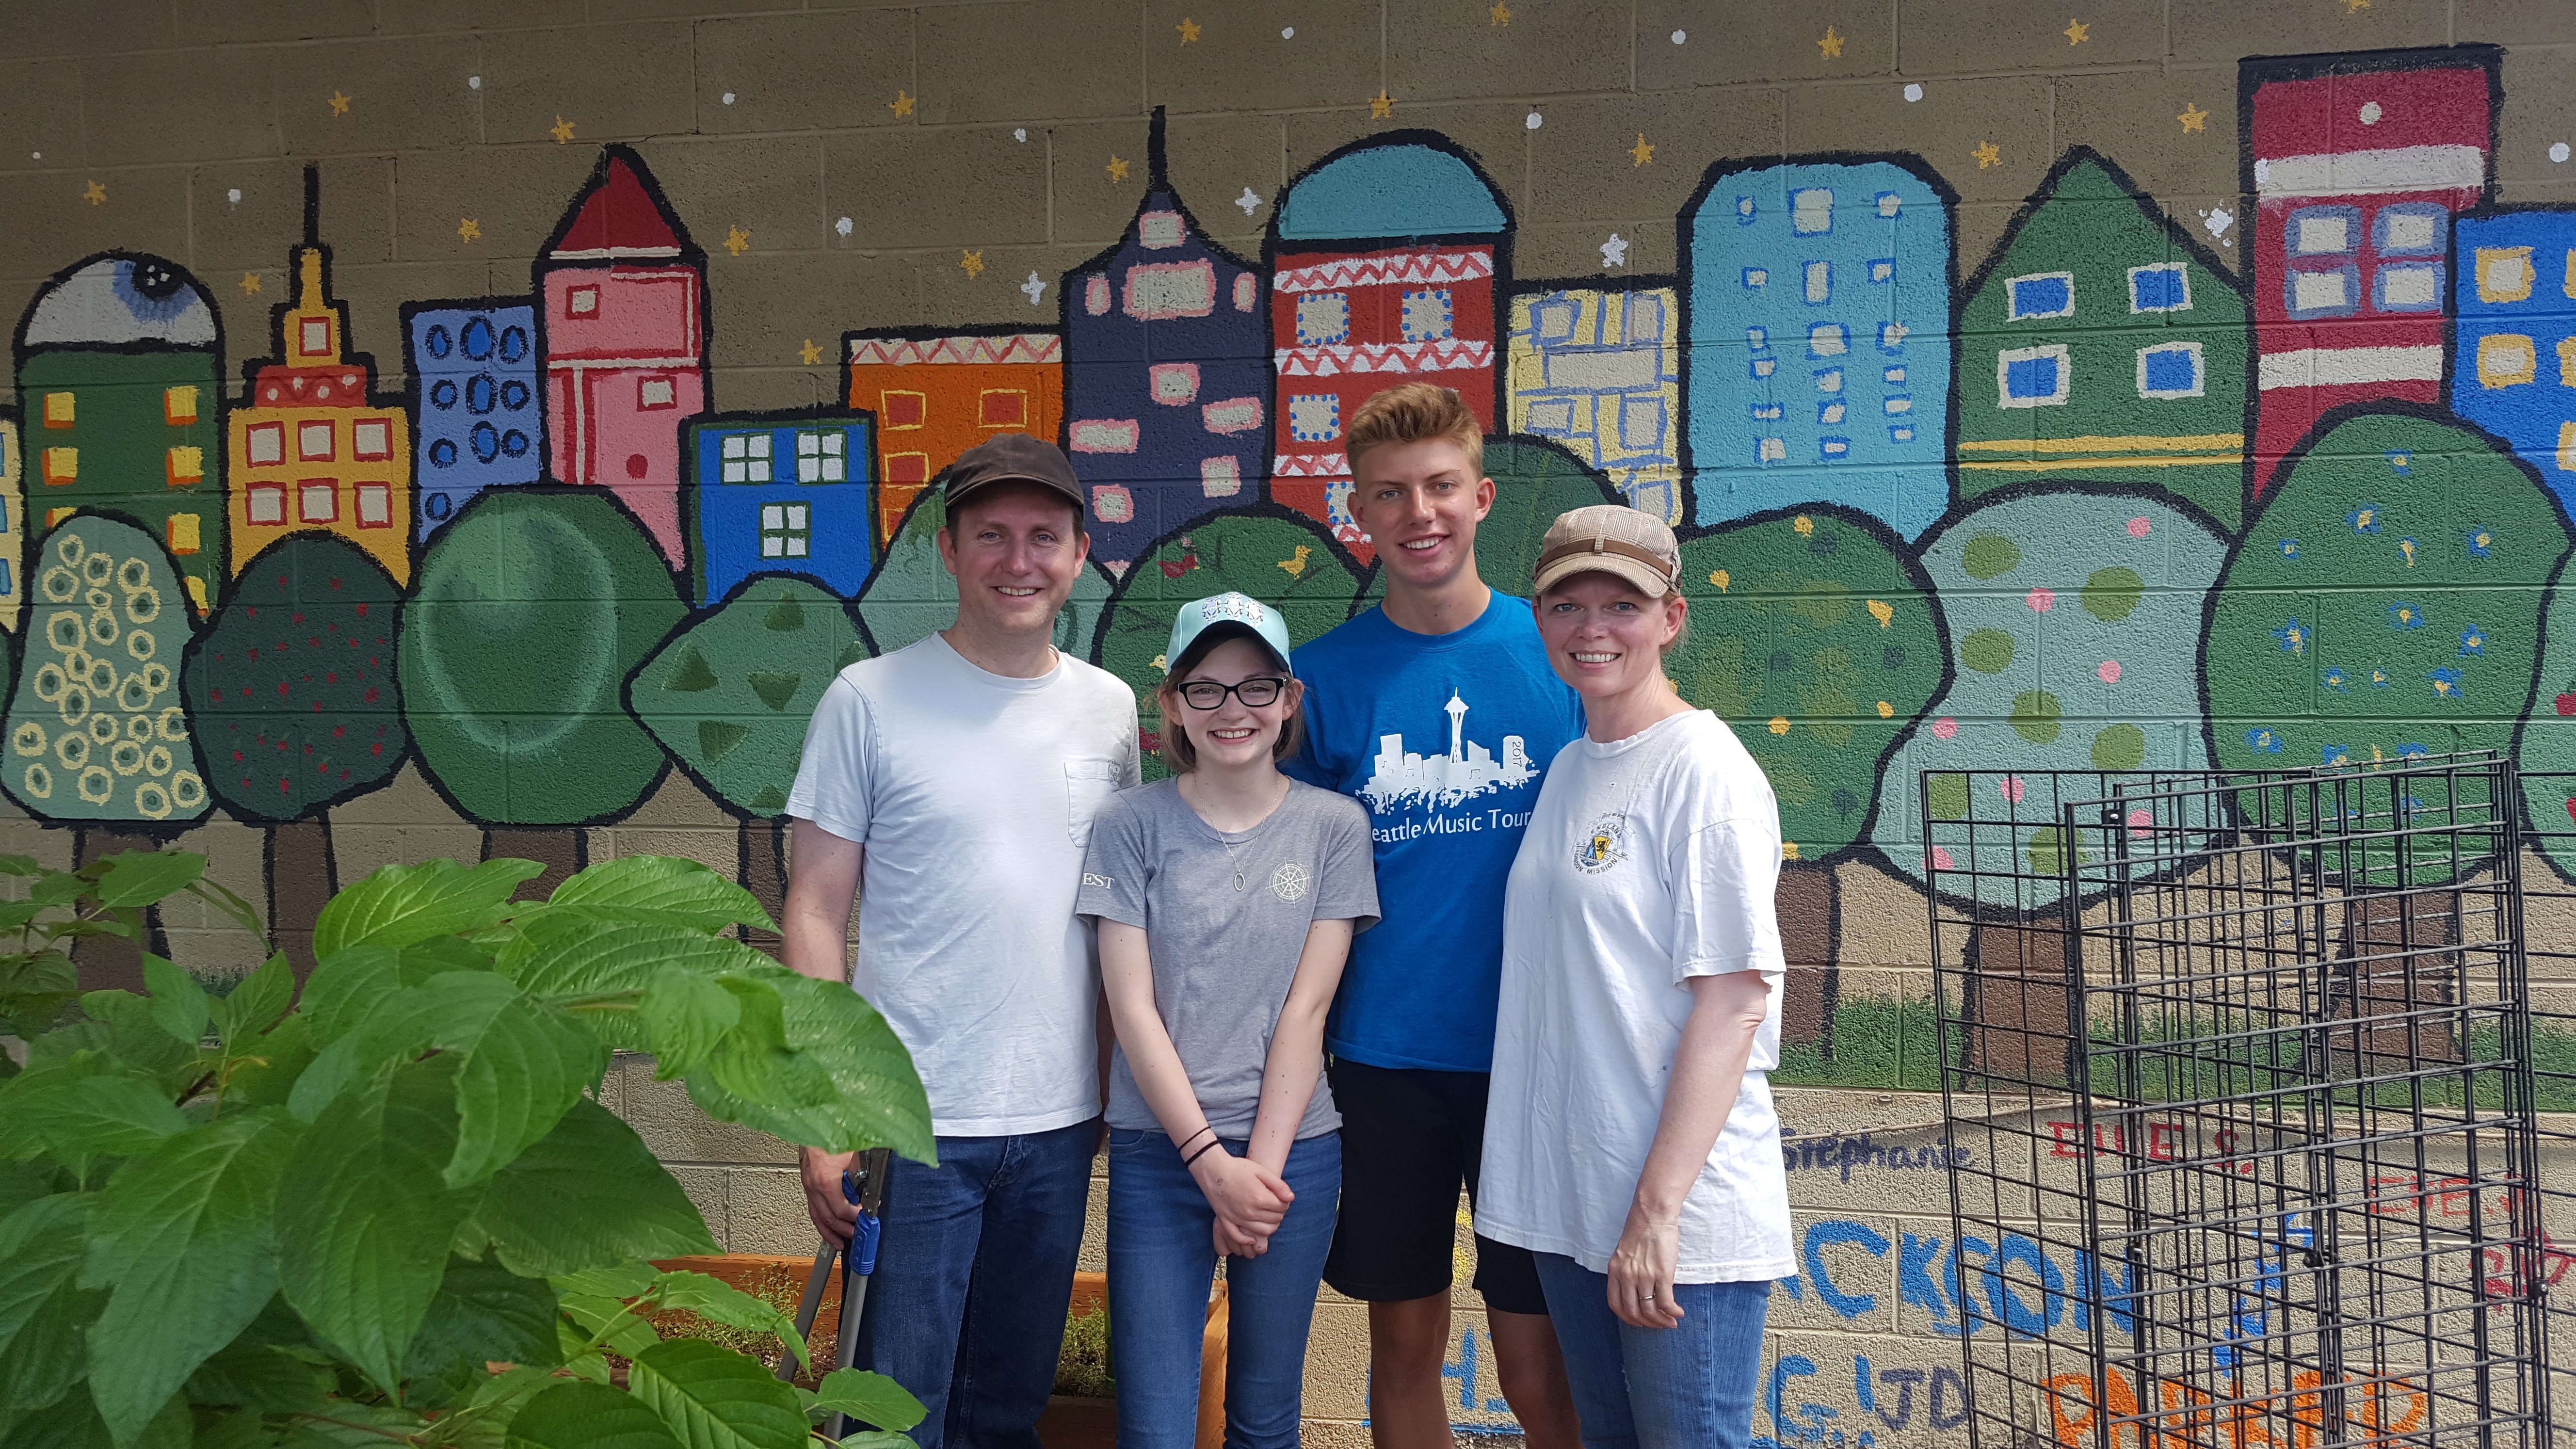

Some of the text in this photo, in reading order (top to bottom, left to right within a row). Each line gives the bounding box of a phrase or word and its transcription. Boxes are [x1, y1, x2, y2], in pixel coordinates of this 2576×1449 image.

[1512, 741, 1522, 767] 2017
[1372, 809, 1531, 842] eattle Music Tour
[1591, 823, 1621, 838] ENGLAND
[1573, 850, 1617, 874] LONDON MISSION
[1082, 872, 1115, 889] EST
[1778, 1221, 2135, 1340] CKSON
